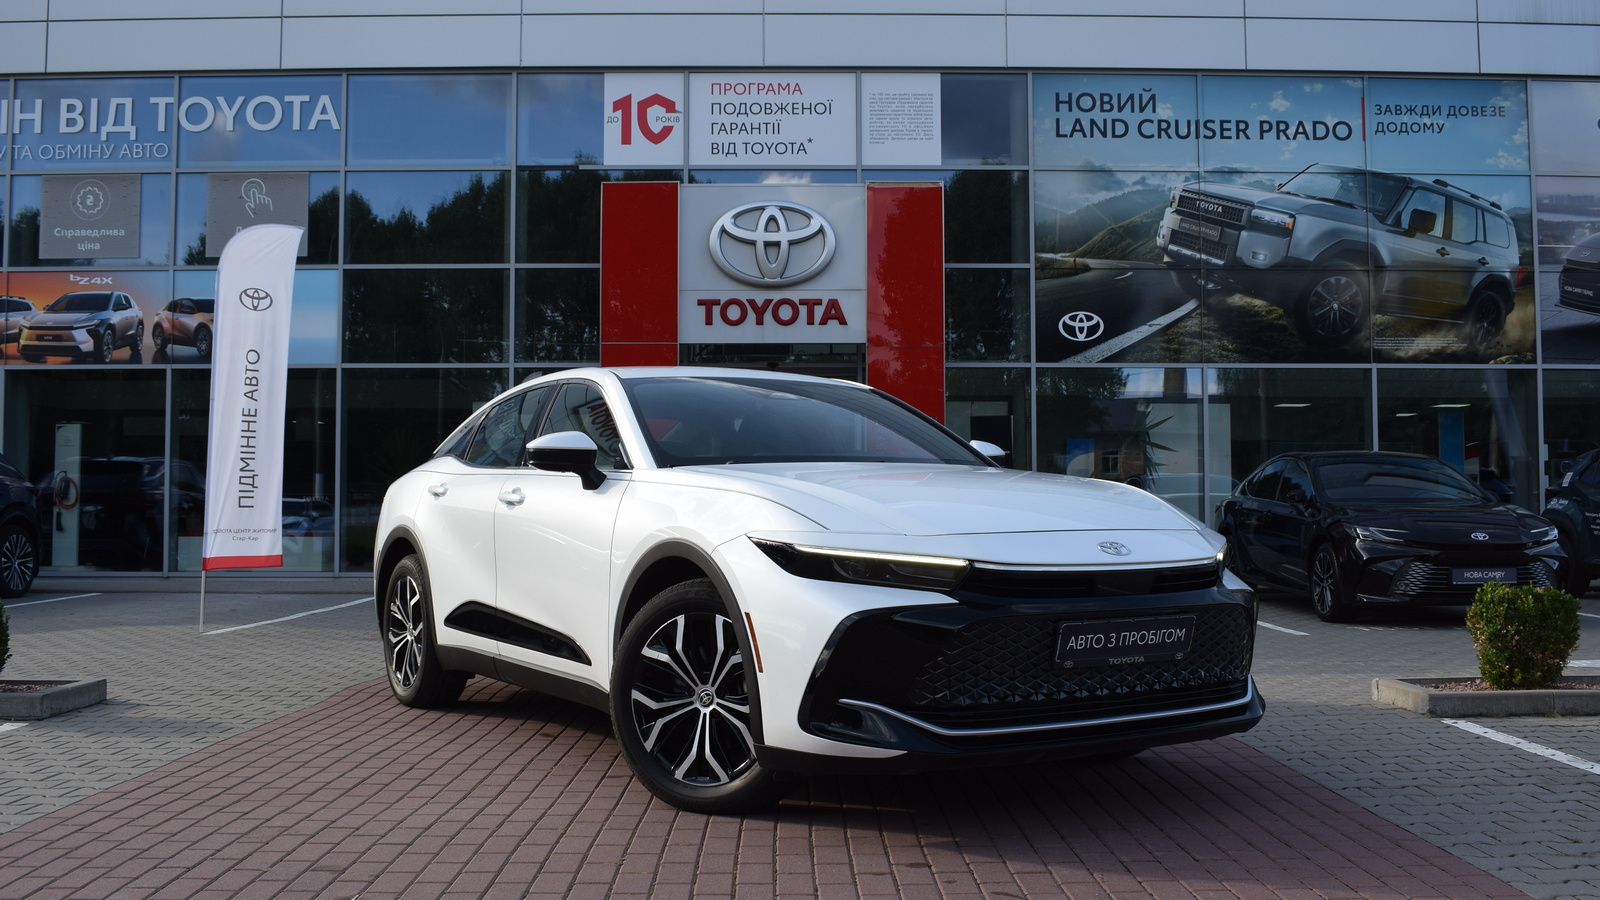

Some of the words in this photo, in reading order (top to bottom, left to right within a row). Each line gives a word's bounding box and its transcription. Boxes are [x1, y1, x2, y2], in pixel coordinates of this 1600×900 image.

[710, 82, 803, 95] ПРОГРАМА
[710, 99, 833, 117] ПОДОВЖЕНОЇ
[1055, 88, 1157, 113] НОВИЙ
[59, 96, 137, 141] ВІД
[150, 94, 341, 133] TOYOTA
[1374, 104, 1442, 118] ЗАВЖДИ
[1446, 105, 1506, 119] ДОВЕЗЕ
[606, 116, 619, 124] ДО
[710, 119, 782, 135] ГАРАНТІЇ
[1375, 121, 1445, 135] ДОДОМУ
[1055, 118, 1129, 138] LAND
[1137, 118, 1251, 140] CRUISER
[1259, 119, 1353, 141] PRADO
[12, 145, 33, 160] ТА
[38, 143, 115, 160] ОБМІНУ
[119, 142, 169, 159] АВТО
[710, 142, 738, 157] ВІД
[1196, 201, 1222, 212] TOYOTA
[54, 228, 125, 238] Справедлива
[77, 240, 101, 251] ціна
[697, 298, 848, 326] TOYOTA
[243, 348, 261, 402] АВТО
[238, 407, 259, 509] ПІДМІННЕ
[1066, 634, 1105, 650] АВТО
[1107, 633, 1117, 647] З
[1119, 628, 1186, 646] ПРОБІГОМ
[1108, 656, 1145, 665] TOYOTA
